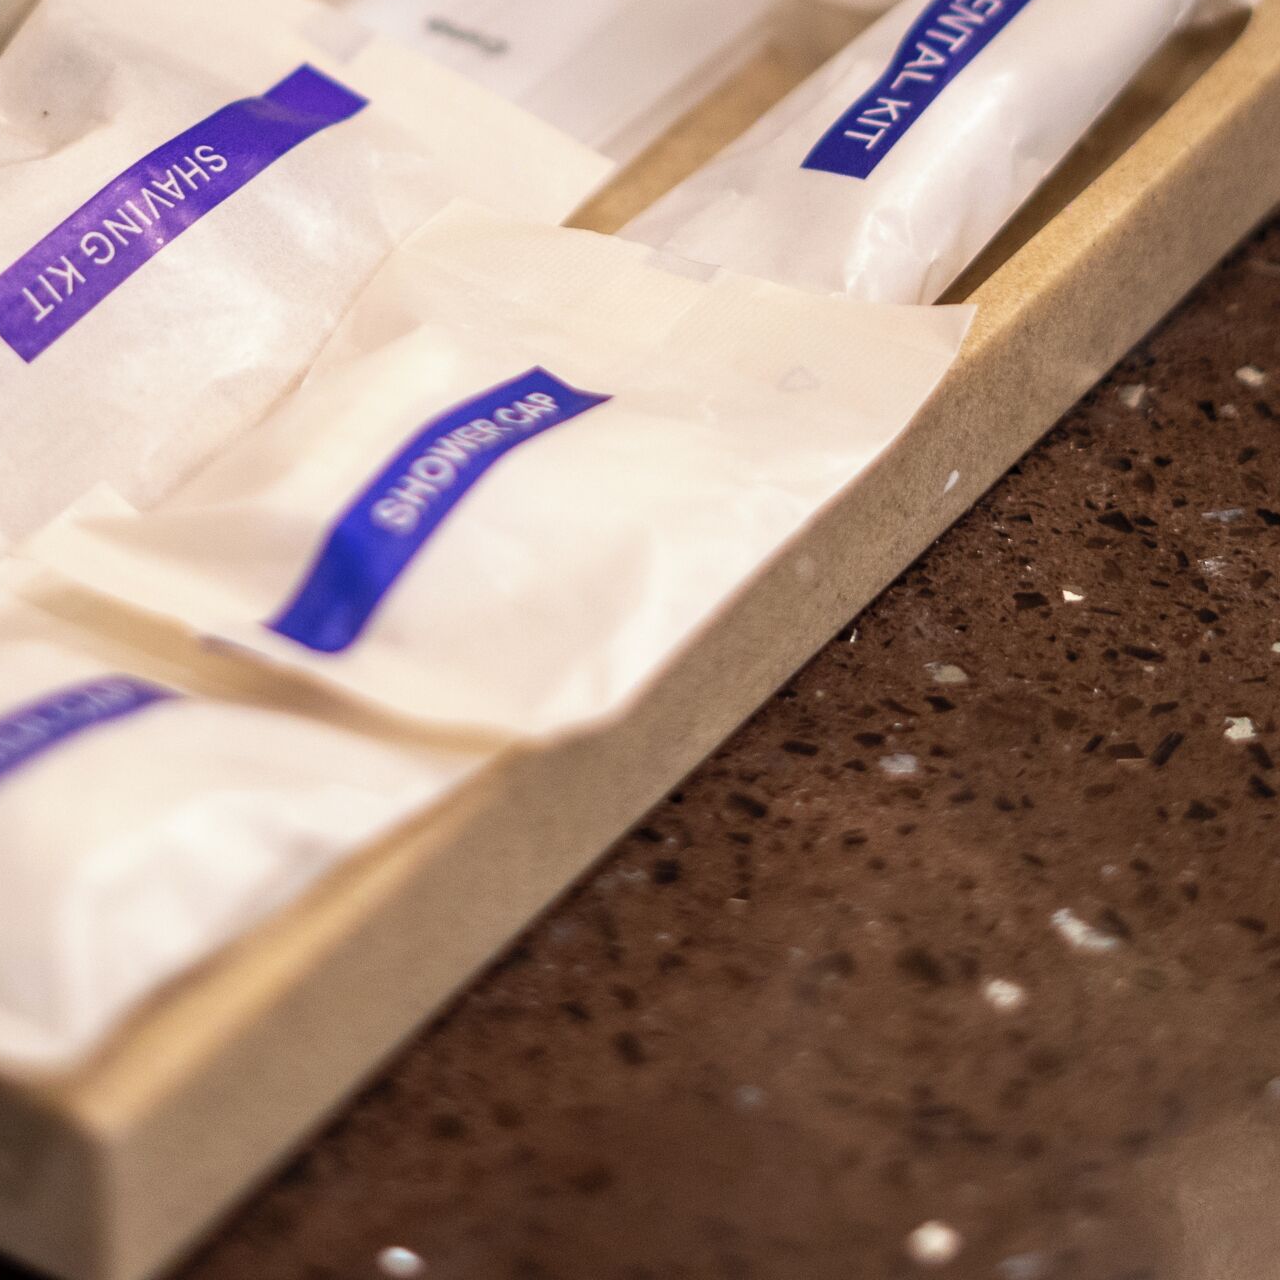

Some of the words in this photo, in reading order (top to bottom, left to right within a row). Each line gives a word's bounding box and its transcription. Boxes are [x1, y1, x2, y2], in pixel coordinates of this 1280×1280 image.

[843, 96, 912, 151] KIT
[79, 144, 229, 266] SHAVING
[21, 254, 88, 322] KIT
[373, 417, 513, 534] SHOWER
[493, 391, 560, 425] CAP
